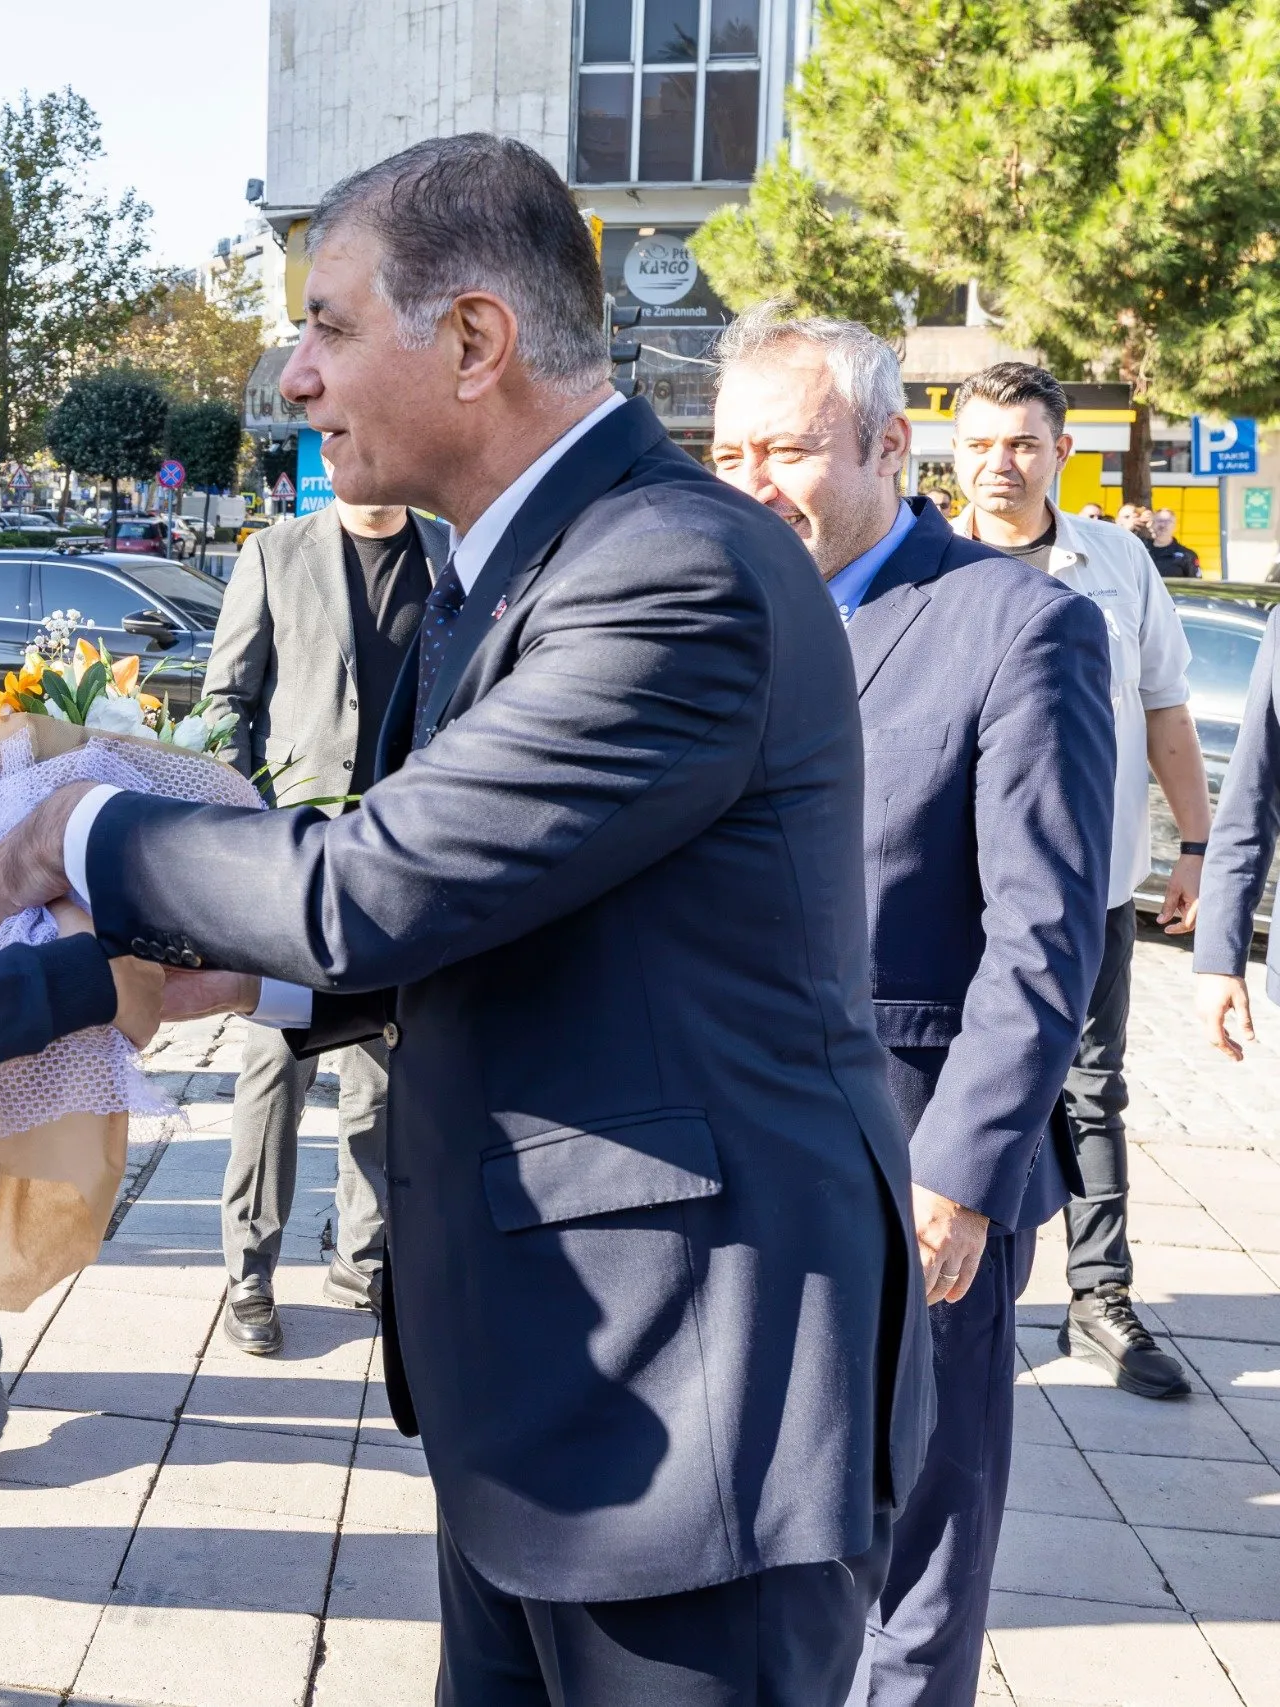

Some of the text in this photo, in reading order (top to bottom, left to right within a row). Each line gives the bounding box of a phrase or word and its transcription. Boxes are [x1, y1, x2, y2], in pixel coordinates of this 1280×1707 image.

[672, 248, 690, 259] Ptt
[639, 261, 689, 275] KARGO
[1199, 415, 1238, 473] P
